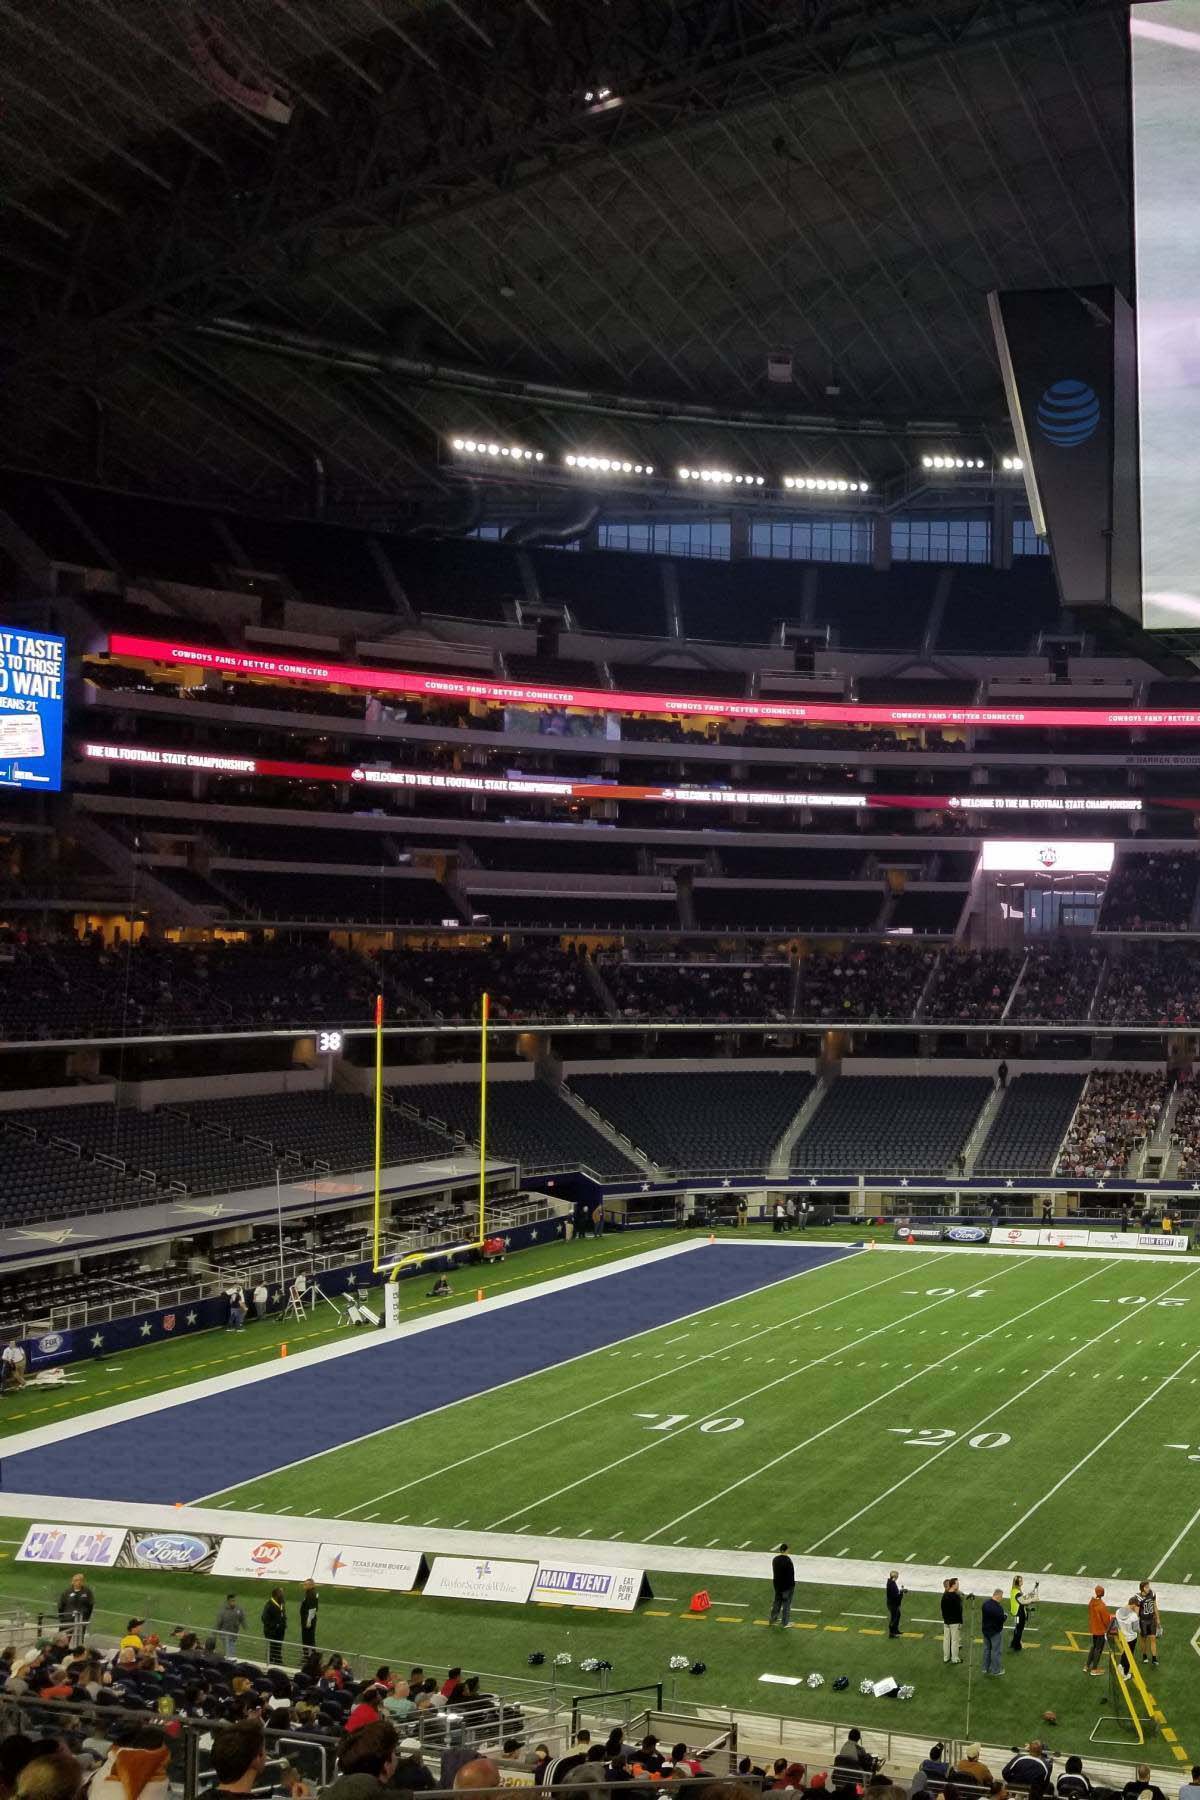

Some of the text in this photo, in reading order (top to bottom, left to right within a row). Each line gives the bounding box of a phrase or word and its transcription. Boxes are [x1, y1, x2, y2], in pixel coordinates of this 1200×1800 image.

[16, 636, 62, 661] TASTE
[7, 654, 22, 670] TO
[24, 657, 60, 676] THOSE
[172, 650, 328, 676] COWBOYS FANS BETTER CONNECTED
[12, 671, 61, 699] WAIT.
[425, 681, 573, 701] COWBOYS FANS BETTER CONNECTED
[120, 748, 160, 762] FOOTBALL
[162, 752, 186, 765] STATE
[188, 755, 255, 771] CHAMPIONSHIPS
[365, 771, 404, 783] WELCOME
[446, 777, 484, 789] FOOTBALL
[486, 780, 507, 790] STATE
[509, 781, 572, 794] CHAMPIONSHIPS
[320, 1032, 341, 1050] 38
[956, 1230, 976, 1239] Ford
[1156, 1238, 1174, 1246] EVENT
[146, 1539, 191, 1561] Ford
[256, 1546, 277, 1559] DQ
[539, 1570, 610, 1591] MAIN EVENT
[618, 1585, 633, 1593] BOWL
[624, 1577, 634, 1585] EAT
